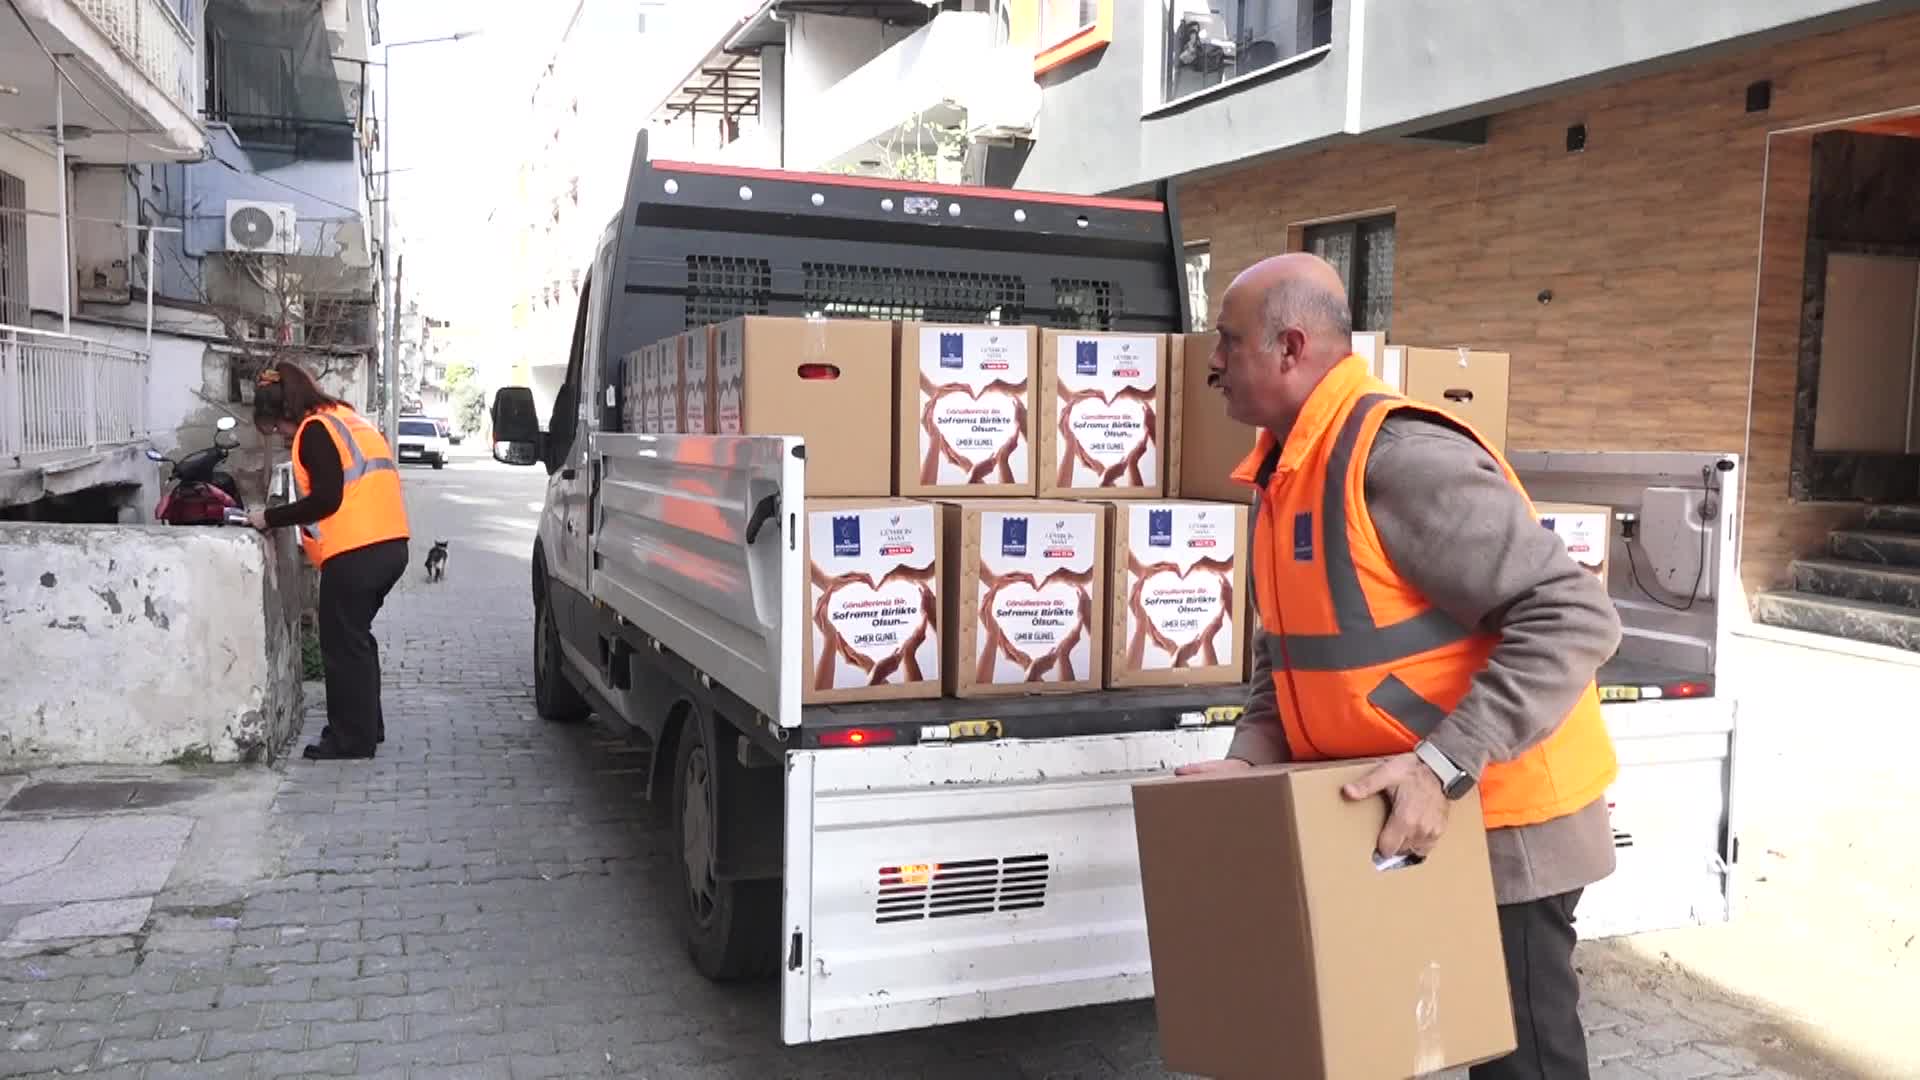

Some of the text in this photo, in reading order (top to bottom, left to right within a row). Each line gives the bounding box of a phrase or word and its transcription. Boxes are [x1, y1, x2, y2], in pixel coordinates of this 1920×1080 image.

[1144, 595, 1217, 606] Soframız Birlikte
[832, 606, 918, 620] Soframız Birlikte
[996, 607, 1074, 618] Soframız Birlikte
